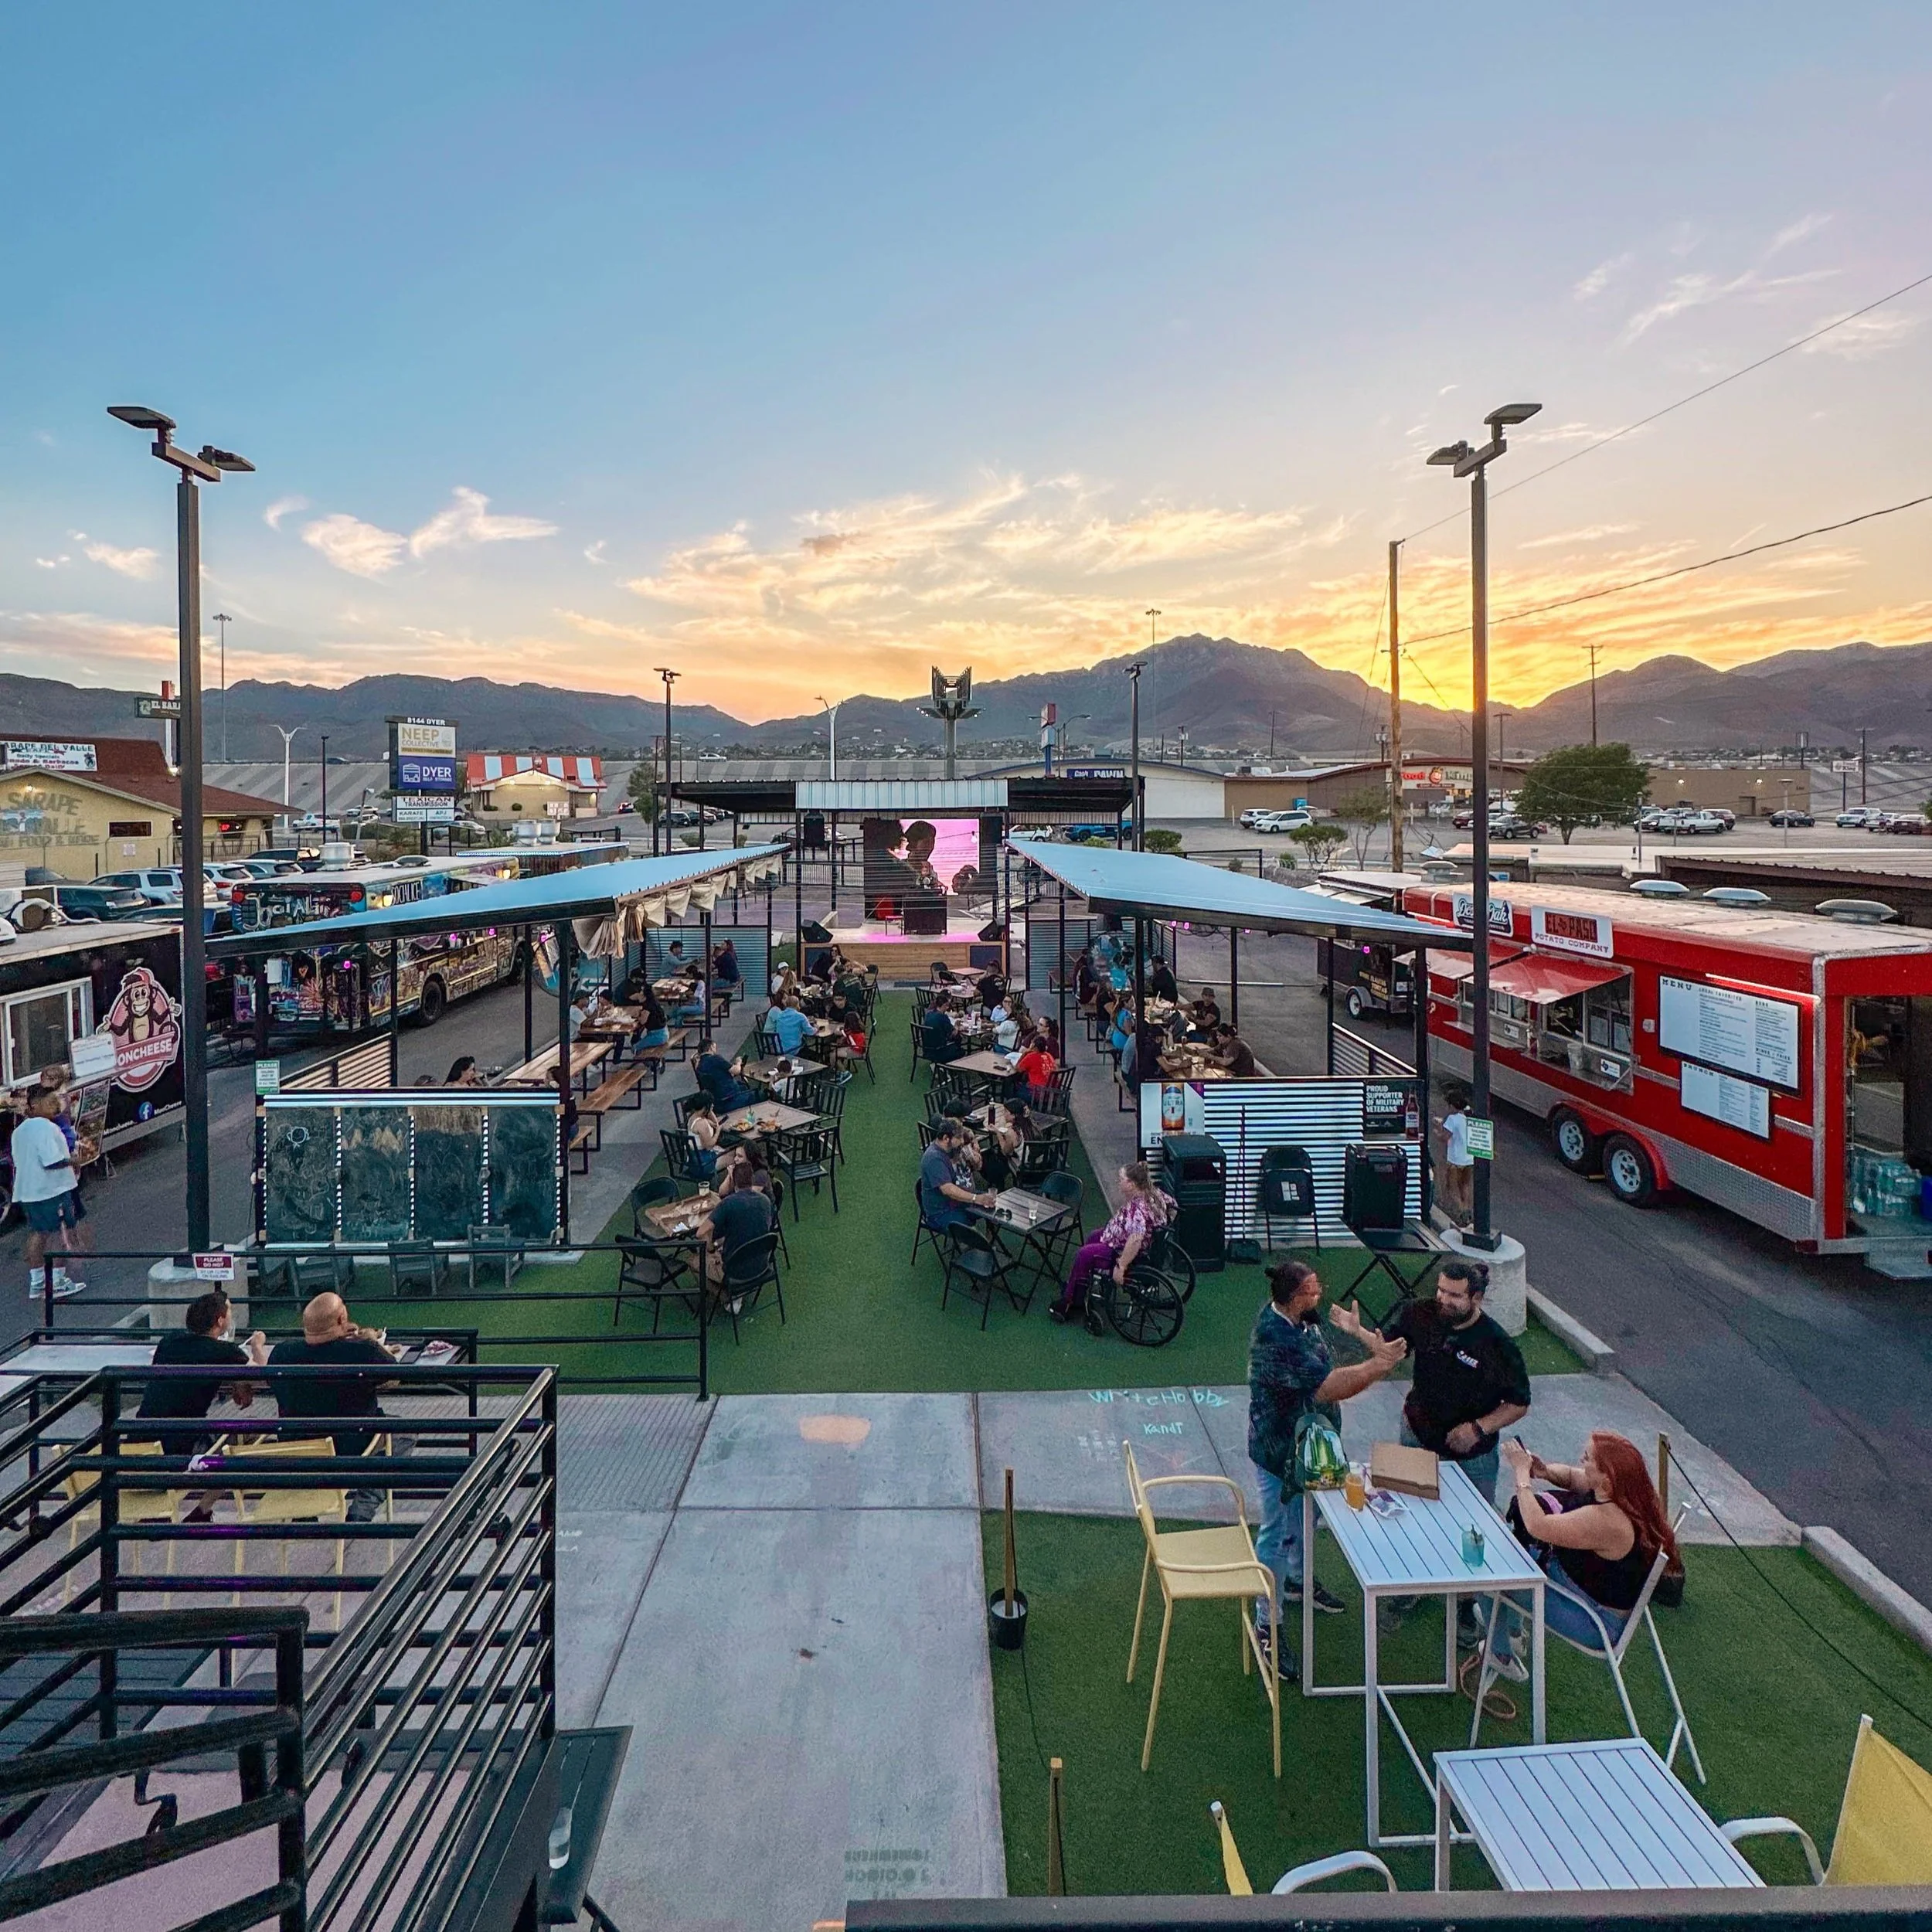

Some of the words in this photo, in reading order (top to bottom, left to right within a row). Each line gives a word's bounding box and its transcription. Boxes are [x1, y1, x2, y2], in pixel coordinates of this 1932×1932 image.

[151, 700, 161, 709] EL
[426, 717, 446, 726] DYER
[402, 727, 440, 741] NEEP
[402, 740, 439, 748] COLLECTIVE
[422, 766, 452, 777] DYER
[1094, 770, 1124, 778] PAWN
[1400, 771, 1425, 781] ood
[1546, 913, 1560, 934] EL
[1569, 917, 1597, 941] PASO
[1535, 932, 1564, 945] POTATO
[1568, 939, 1609, 954] COMPANY
[1662, 978, 1692, 991] MENU
[117, 1037, 173, 1066] ONCHEESE
